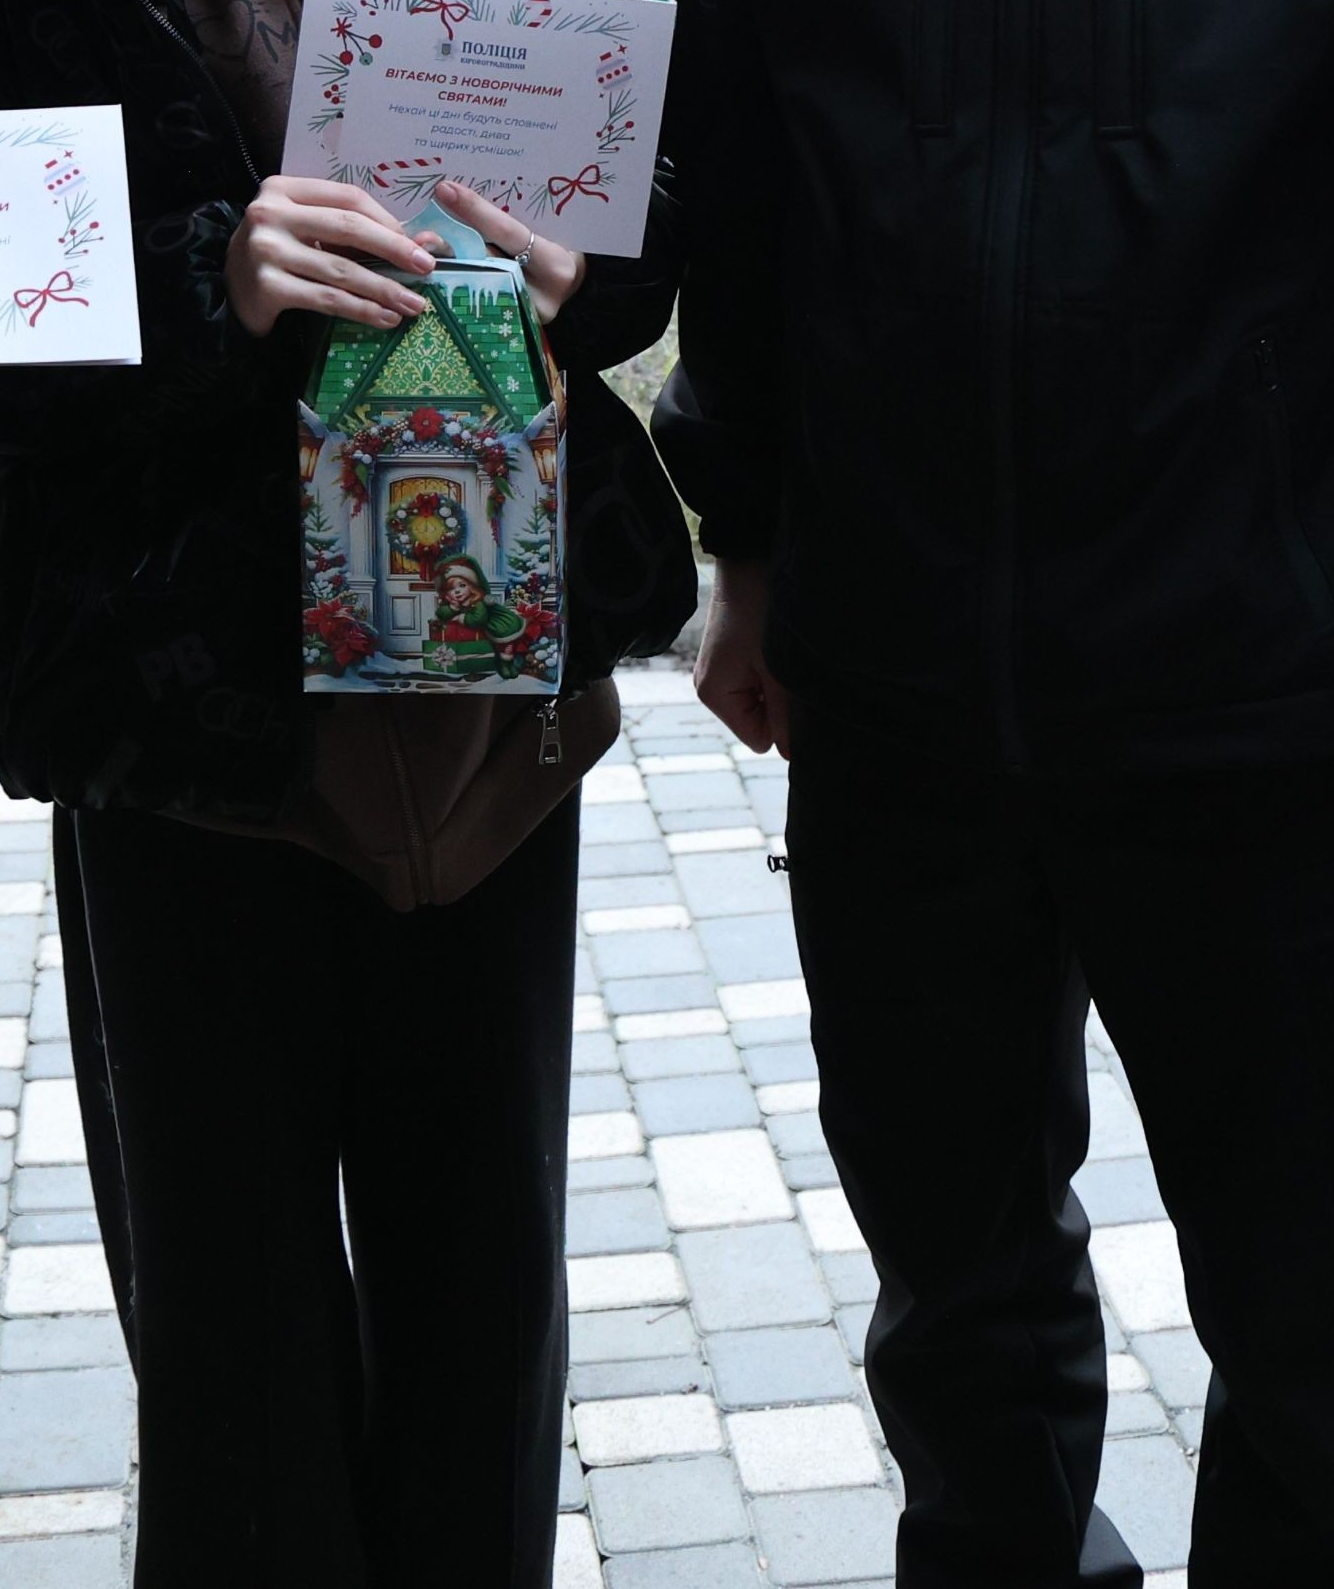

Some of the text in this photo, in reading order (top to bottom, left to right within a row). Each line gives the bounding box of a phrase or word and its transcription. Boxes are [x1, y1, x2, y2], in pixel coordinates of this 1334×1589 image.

[461, 41, 528, 61] ПОЛІЦІЯ
[385, 68, 563, 98] ВІТАЄМО З НОВОРІЧНИМИ
[437, 90, 508, 108] СВЯТАМИ!
[388, 103, 559, 131] Нехай ці дні будуть сповнені
[479, 130, 511, 141] дива
[414, 137, 525, 158] та щирих усмішок!
